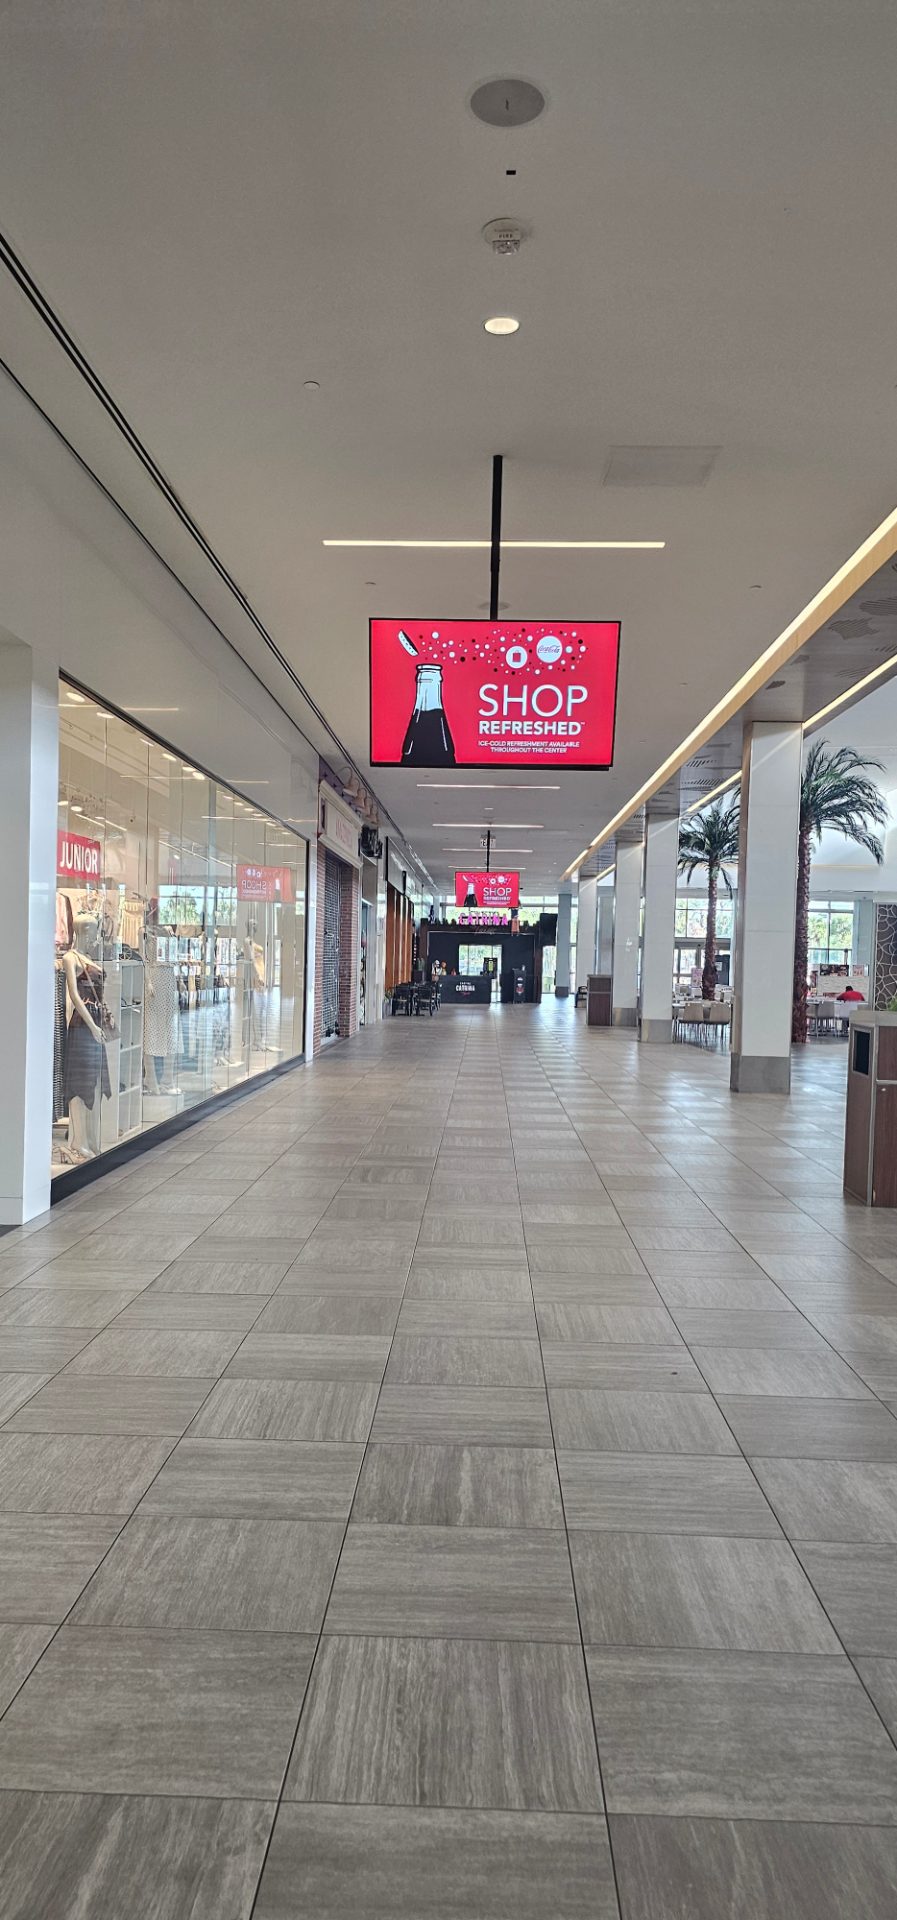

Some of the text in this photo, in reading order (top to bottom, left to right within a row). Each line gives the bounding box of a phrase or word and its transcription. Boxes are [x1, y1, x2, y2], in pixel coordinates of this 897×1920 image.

[478, 683, 588, 717] SHOP
[60, 841, 98, 874] JUNIOR
[483, 887, 512, 897] SHOP
